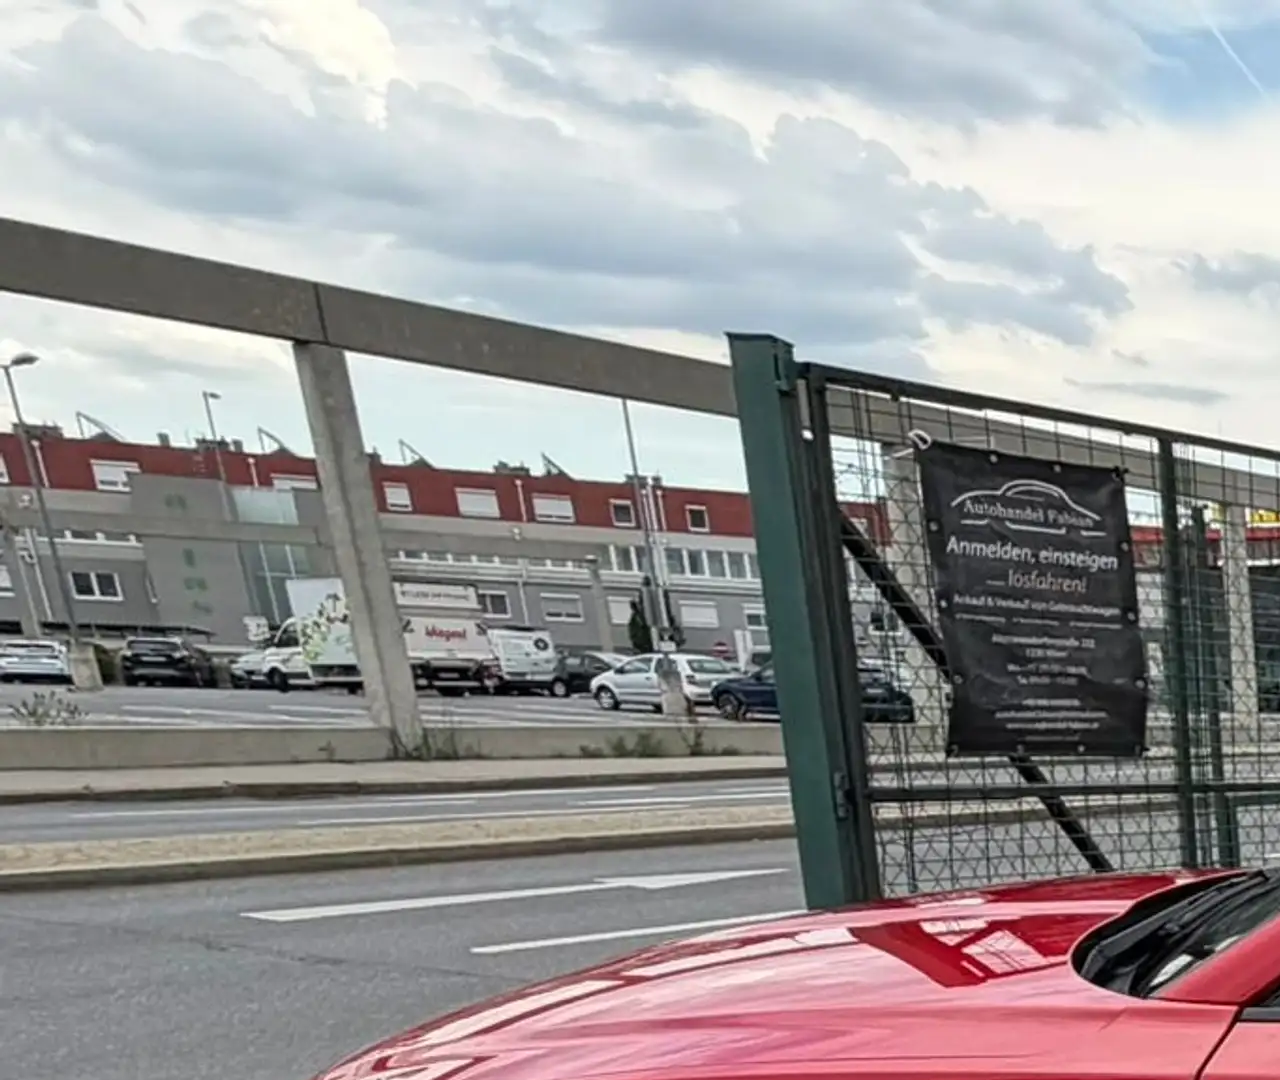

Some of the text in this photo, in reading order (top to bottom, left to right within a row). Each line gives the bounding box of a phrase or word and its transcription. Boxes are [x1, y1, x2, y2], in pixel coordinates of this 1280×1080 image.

[963, 500, 1044, 523] Autohandel
[946, 535, 1118, 572] Anmelden, einsteigen
[1008, 569, 1087, 593] losfahren!
